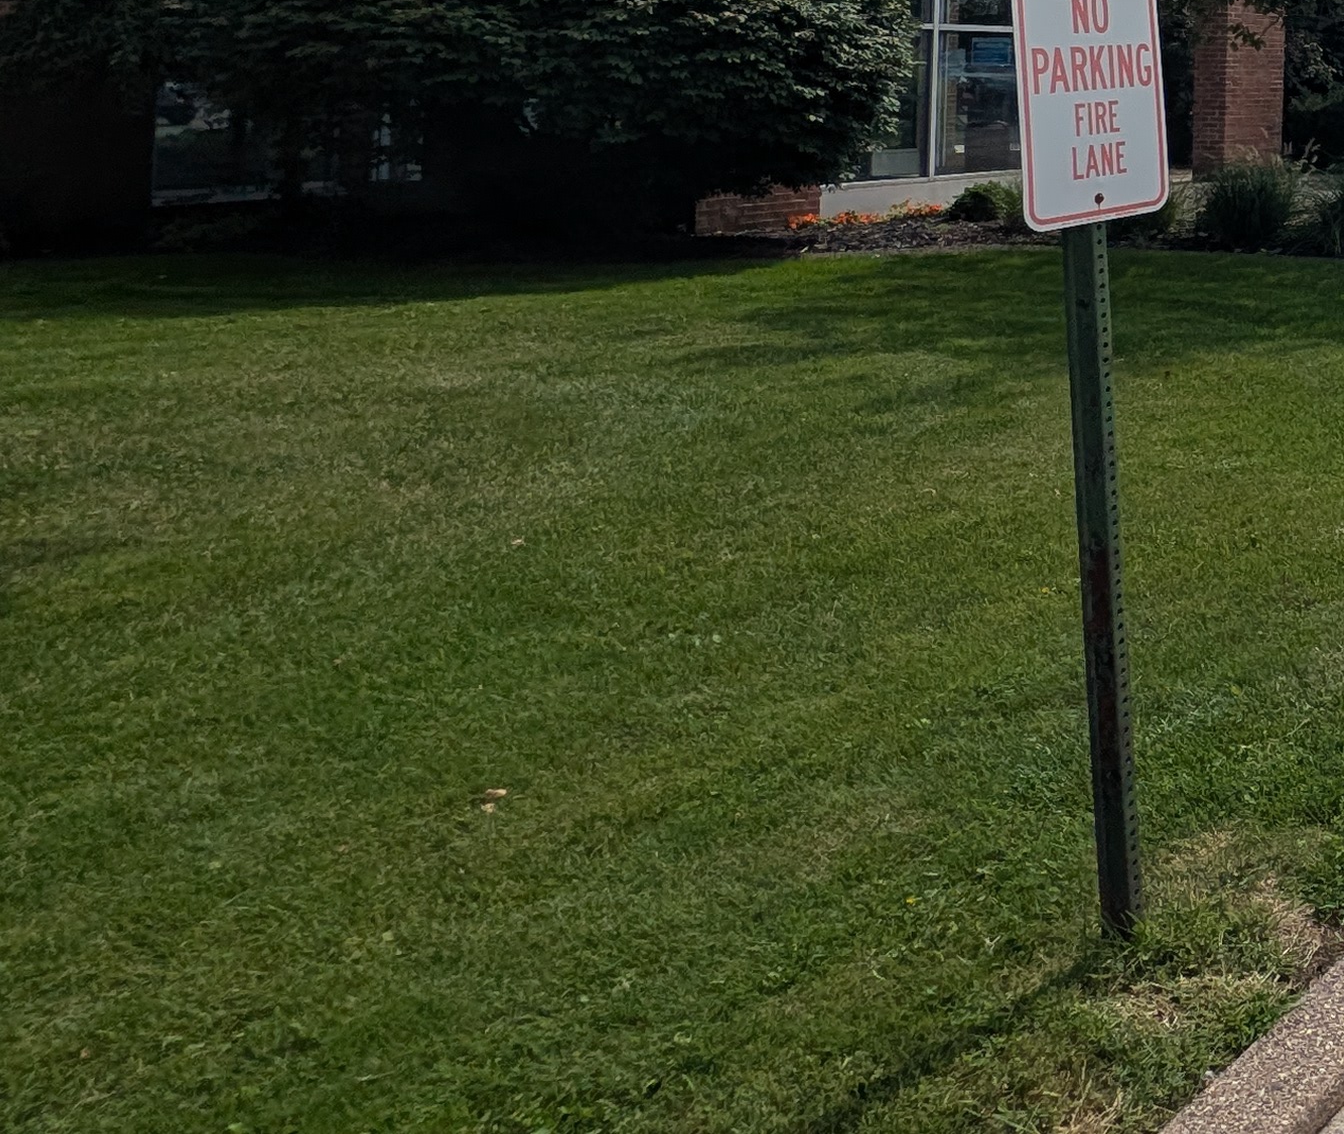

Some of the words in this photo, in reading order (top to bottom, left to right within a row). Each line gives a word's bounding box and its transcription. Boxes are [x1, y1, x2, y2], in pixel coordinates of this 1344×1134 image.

[1031, 43, 1152, 95] PARKING
[1074, 100, 1120, 137] FIRE
[1072, 141, 1127, 180] LANE
